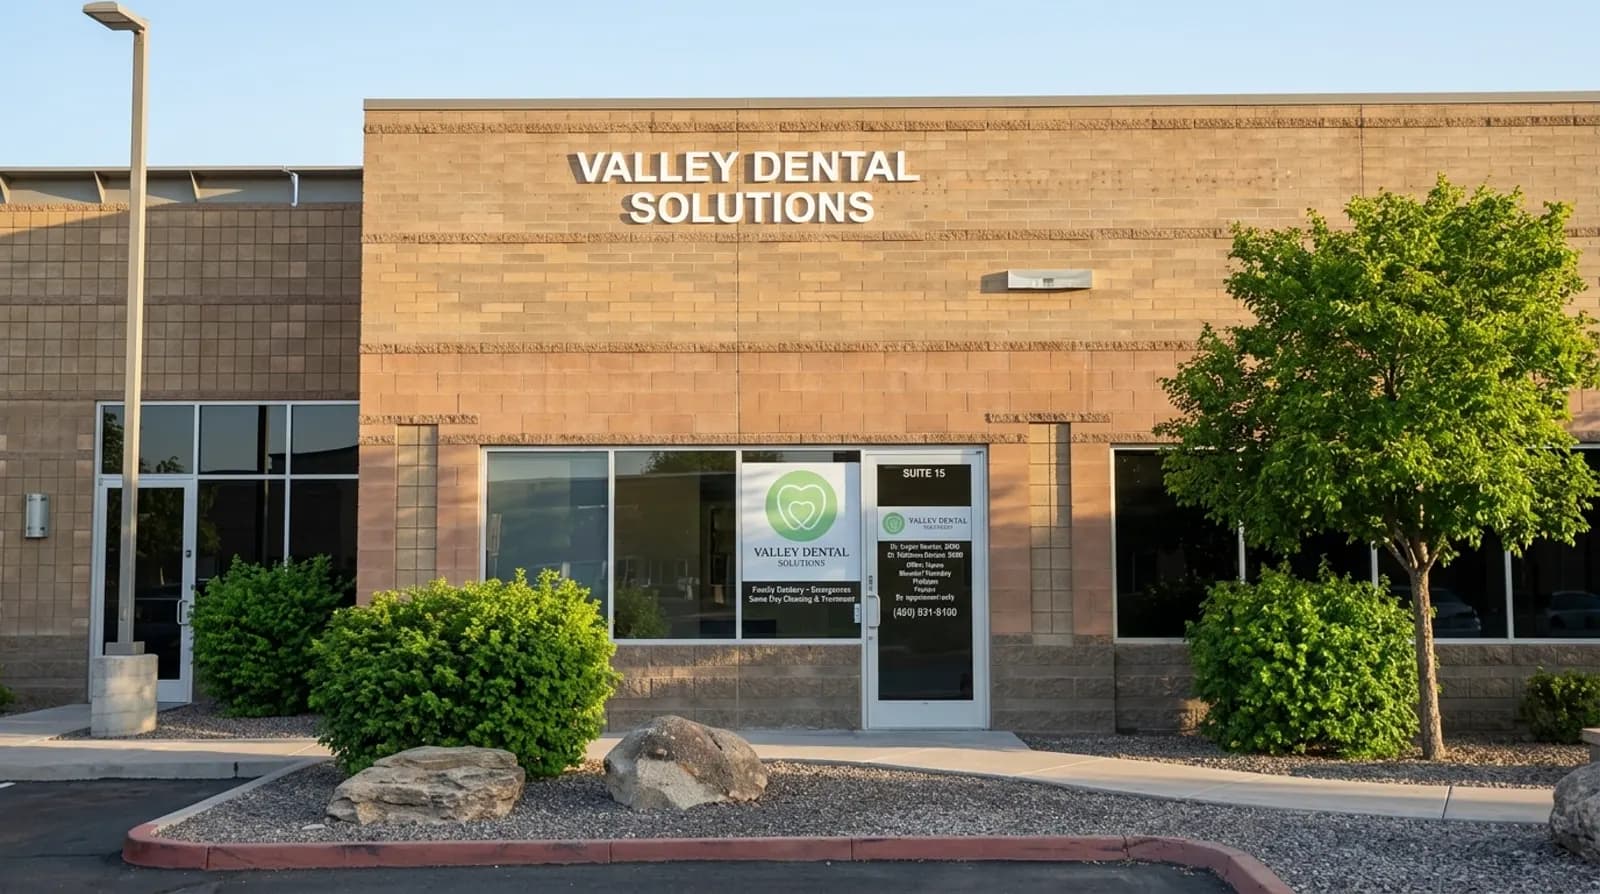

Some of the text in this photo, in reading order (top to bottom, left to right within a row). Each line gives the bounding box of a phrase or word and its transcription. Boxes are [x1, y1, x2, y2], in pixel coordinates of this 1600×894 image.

[576, 151, 921, 183] VALLEY DENTAL
[629, 191, 875, 224] SOLUTIONS
[903, 468, 946, 478] SUITE 15
[754, 547, 850, 557] VALLEY DENTAL
[777, 559, 826, 567] SOLUTIONS
